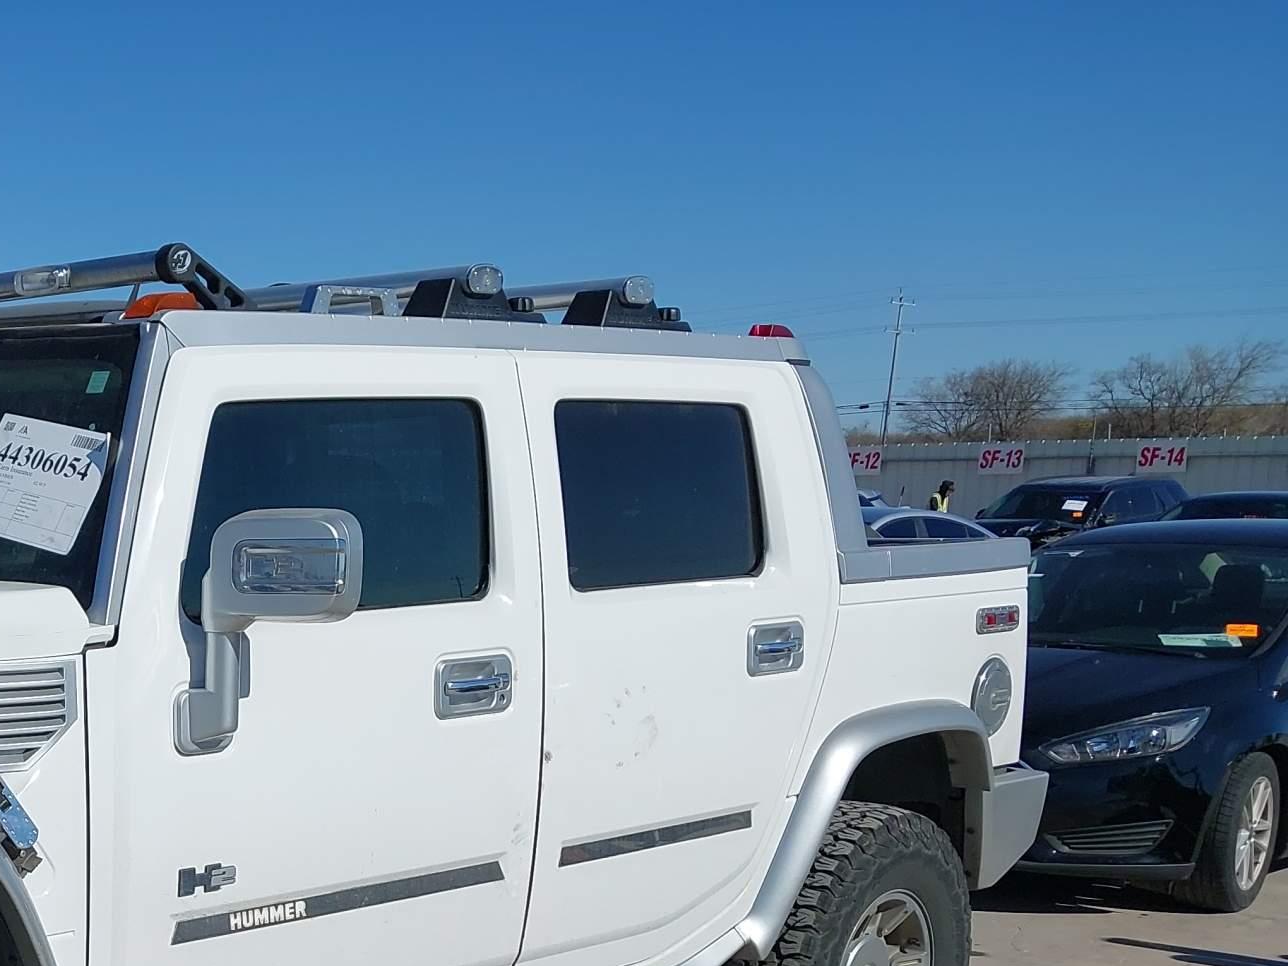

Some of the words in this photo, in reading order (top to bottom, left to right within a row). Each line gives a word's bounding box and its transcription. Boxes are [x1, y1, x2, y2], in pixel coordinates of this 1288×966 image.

[849, 451, 881, 470] F-12
[979, 448, 1024, 469] SF-13
[1138, 446, 1187, 467] SF-14
[177, 862, 237, 897] H2
[229, 900, 307, 931] HUMMER
